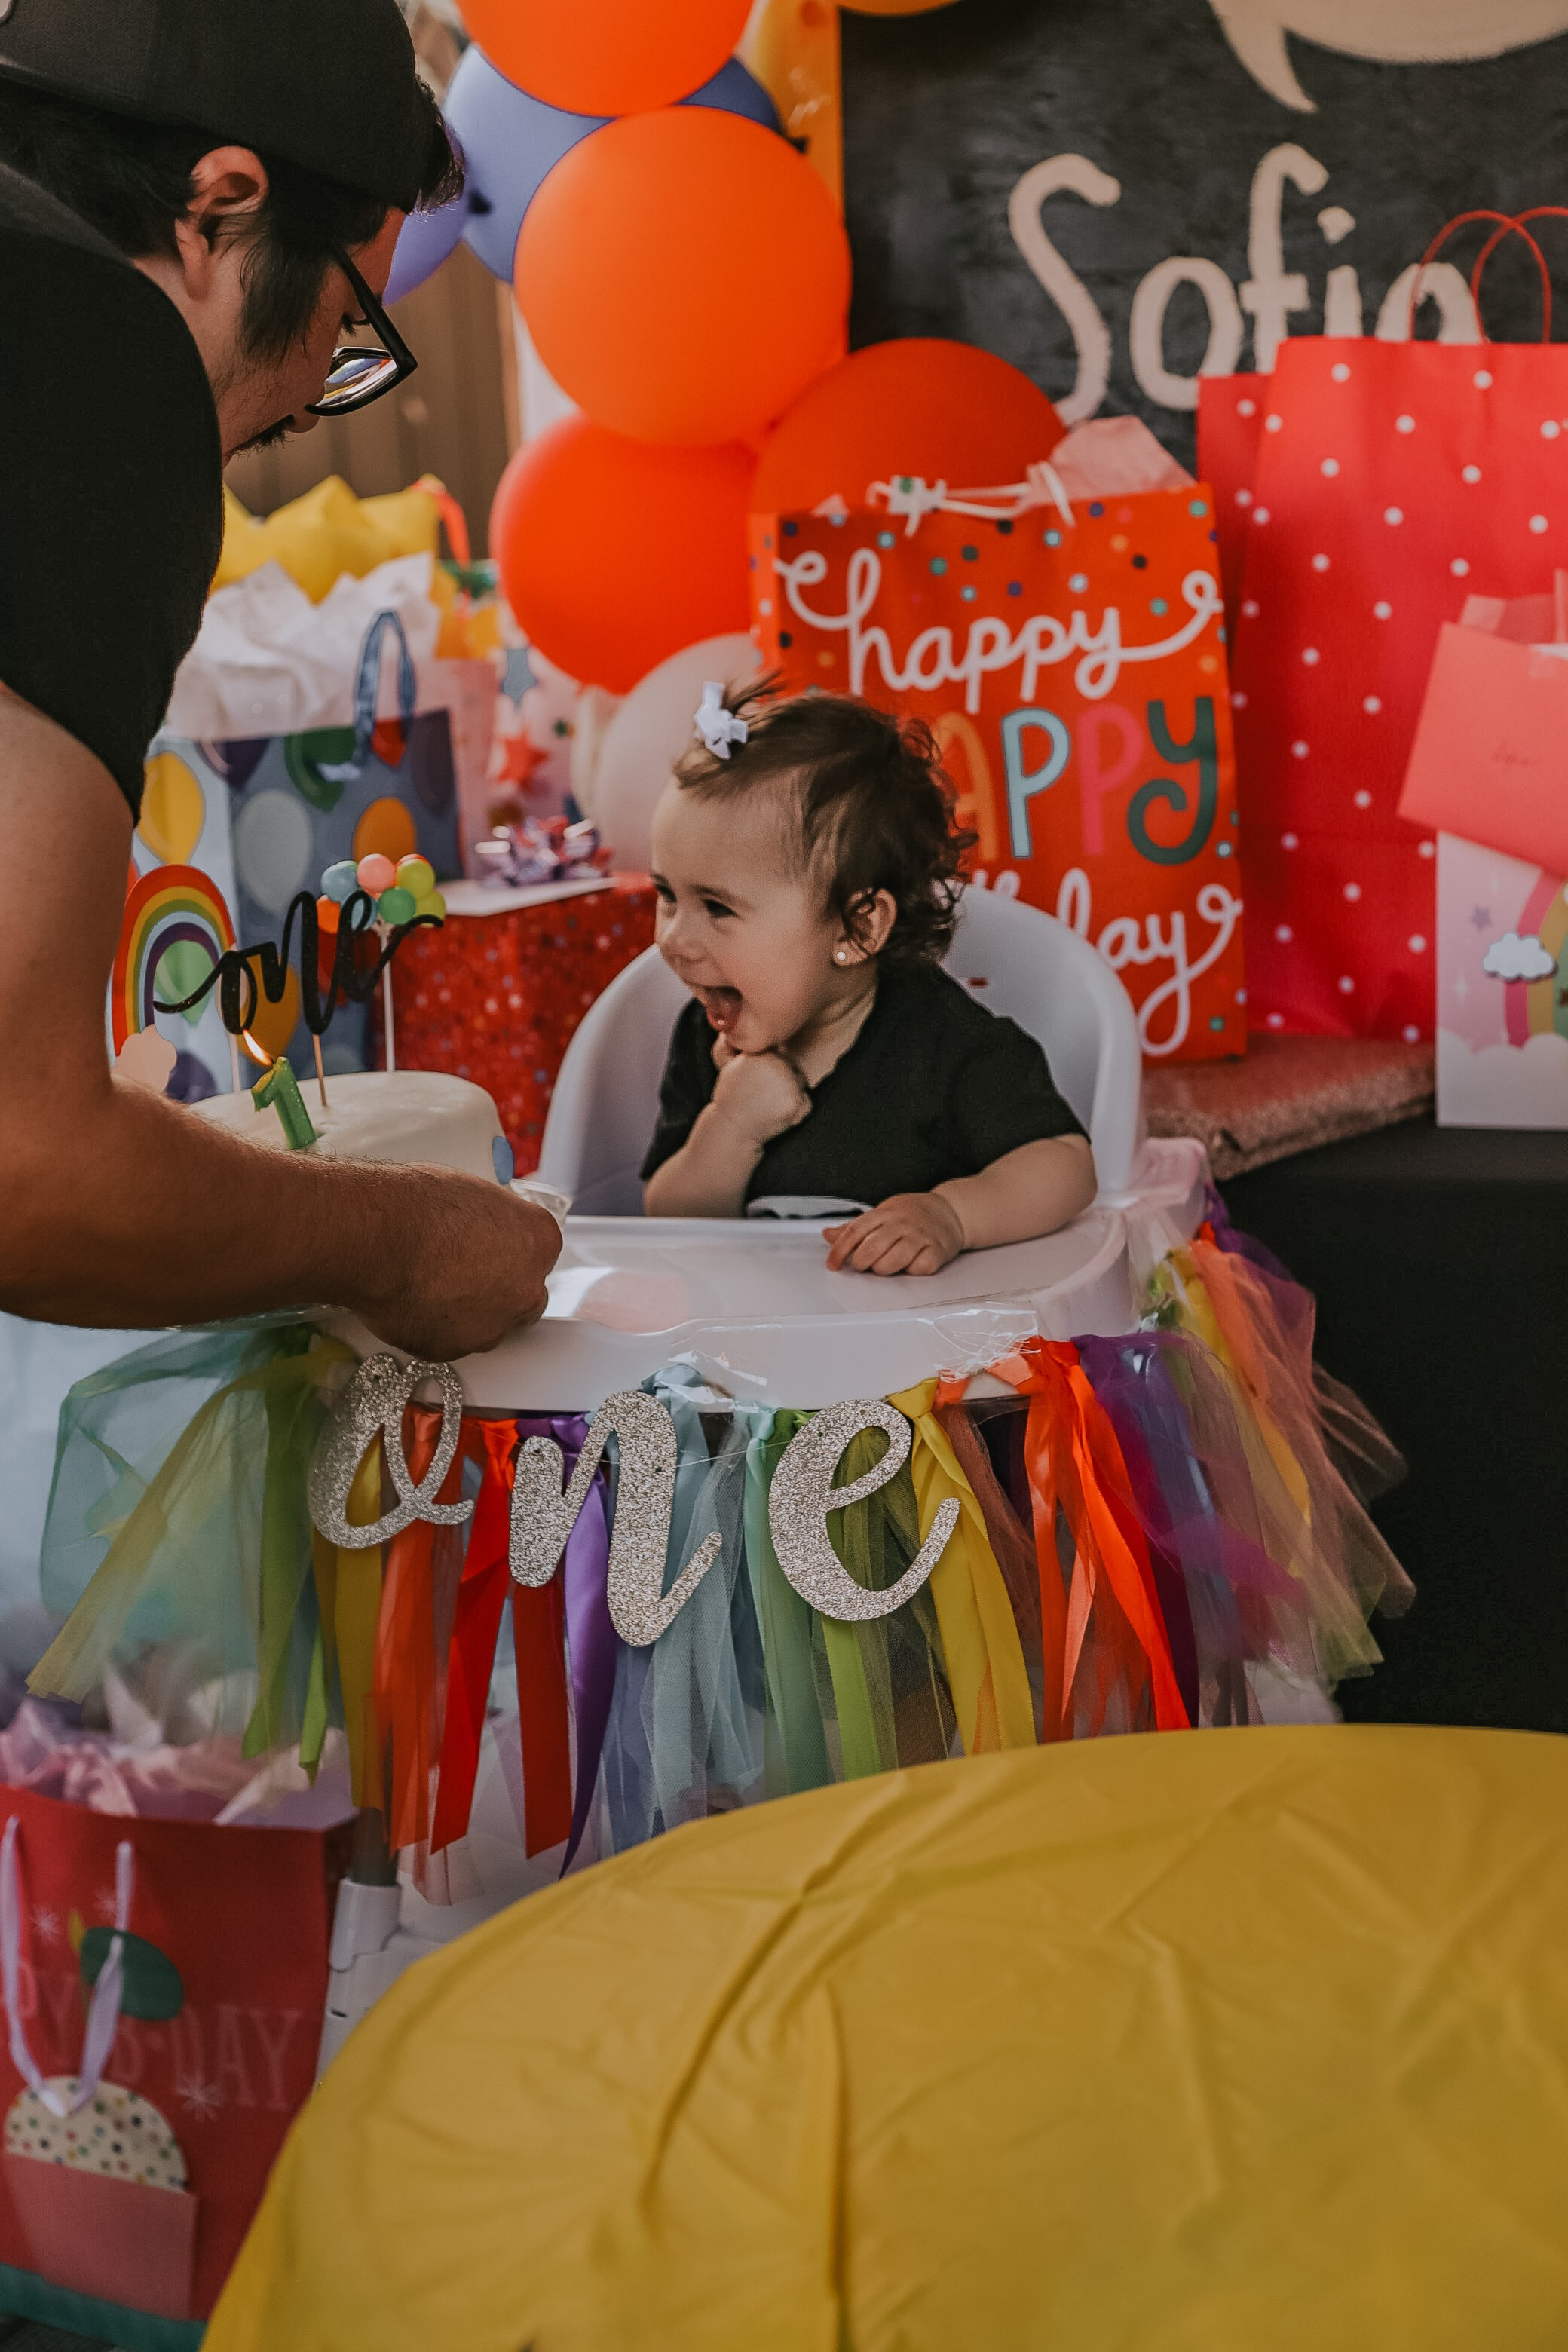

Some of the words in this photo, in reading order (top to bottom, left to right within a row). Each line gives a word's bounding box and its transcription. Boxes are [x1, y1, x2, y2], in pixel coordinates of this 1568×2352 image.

[774, 548, 1224, 715] happy
[153, 890, 443, 1035] one
[250, 1056, 317, 1150] 1
[308, 1352, 960, 1647] one
